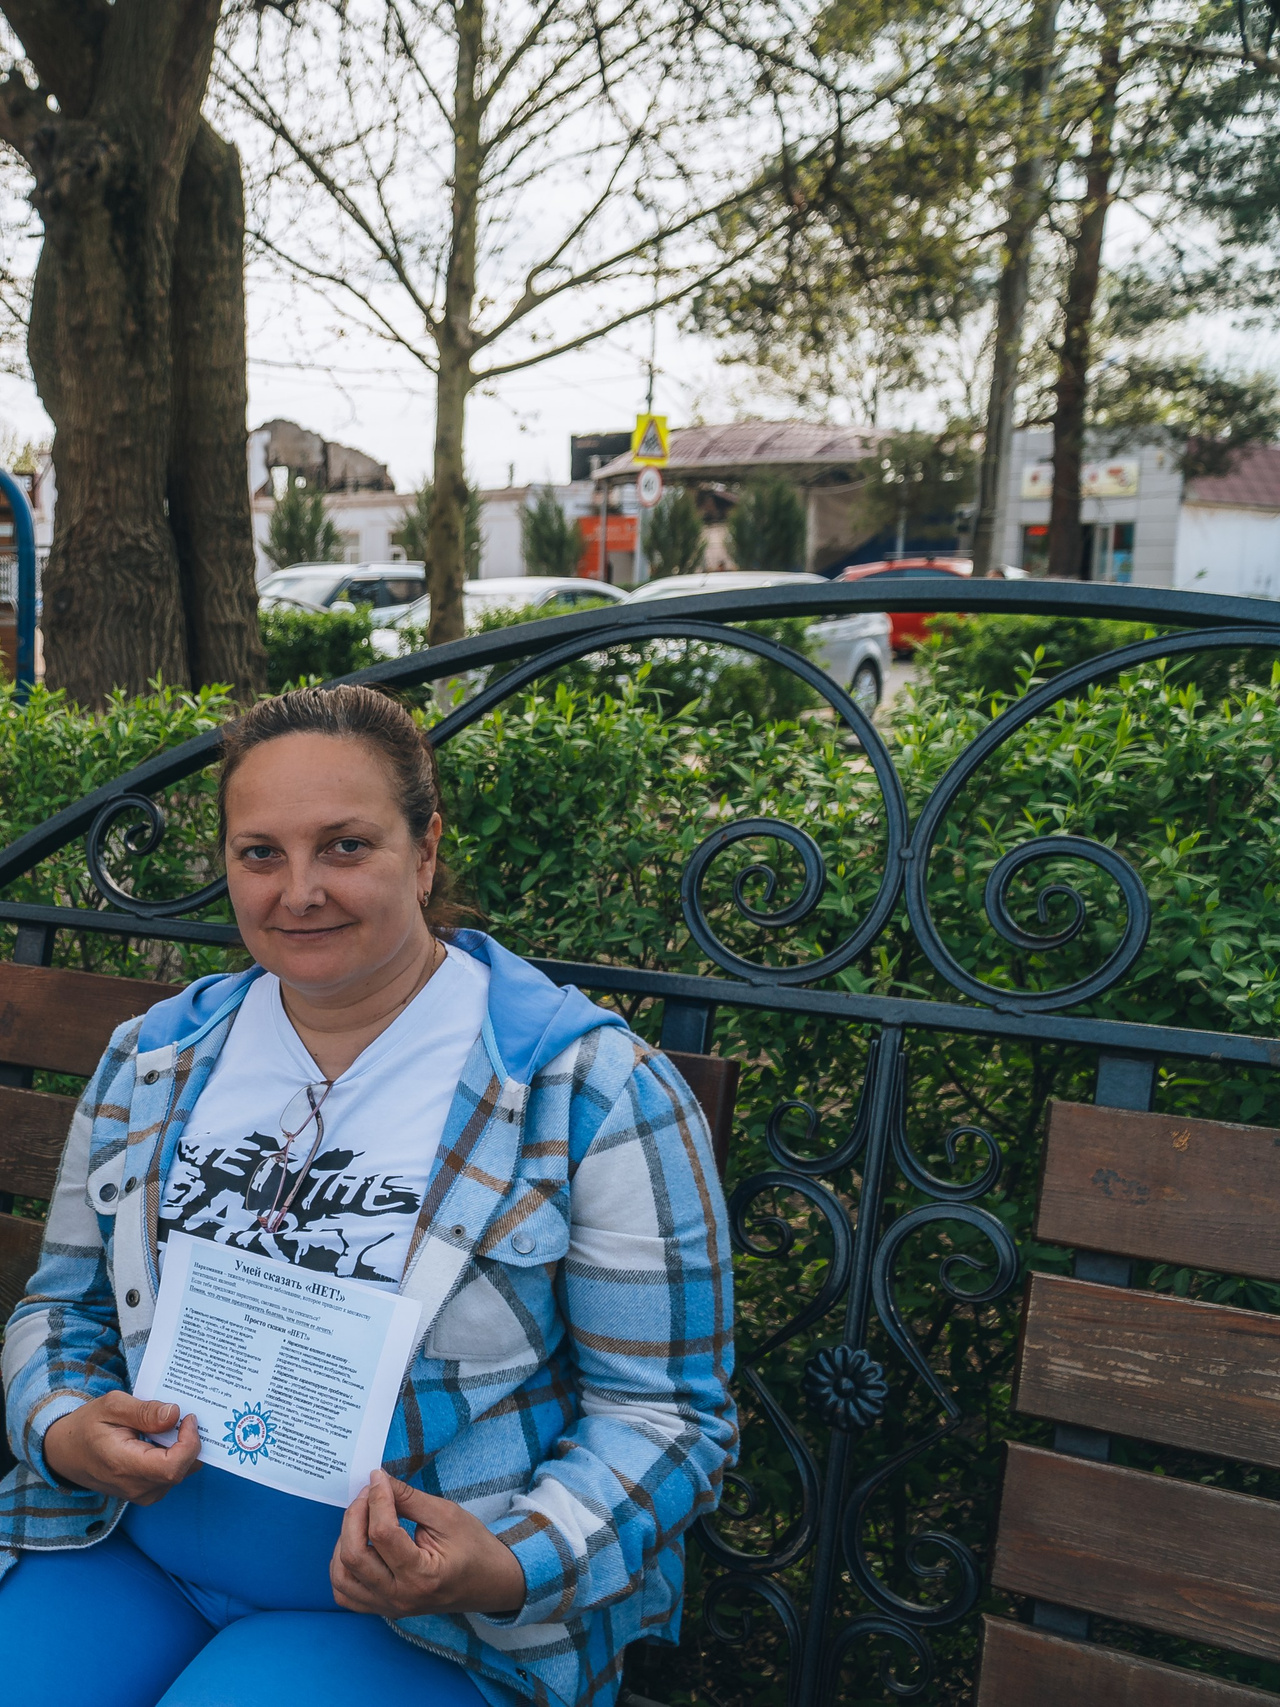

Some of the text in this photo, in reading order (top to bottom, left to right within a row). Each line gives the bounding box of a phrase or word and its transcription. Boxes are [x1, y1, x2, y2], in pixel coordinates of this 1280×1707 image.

[235, 1260, 345, 1301] Умей сказать «НЕТ!»
[244, 1314, 310, 1340] Просто скажи «НЕТ!»
